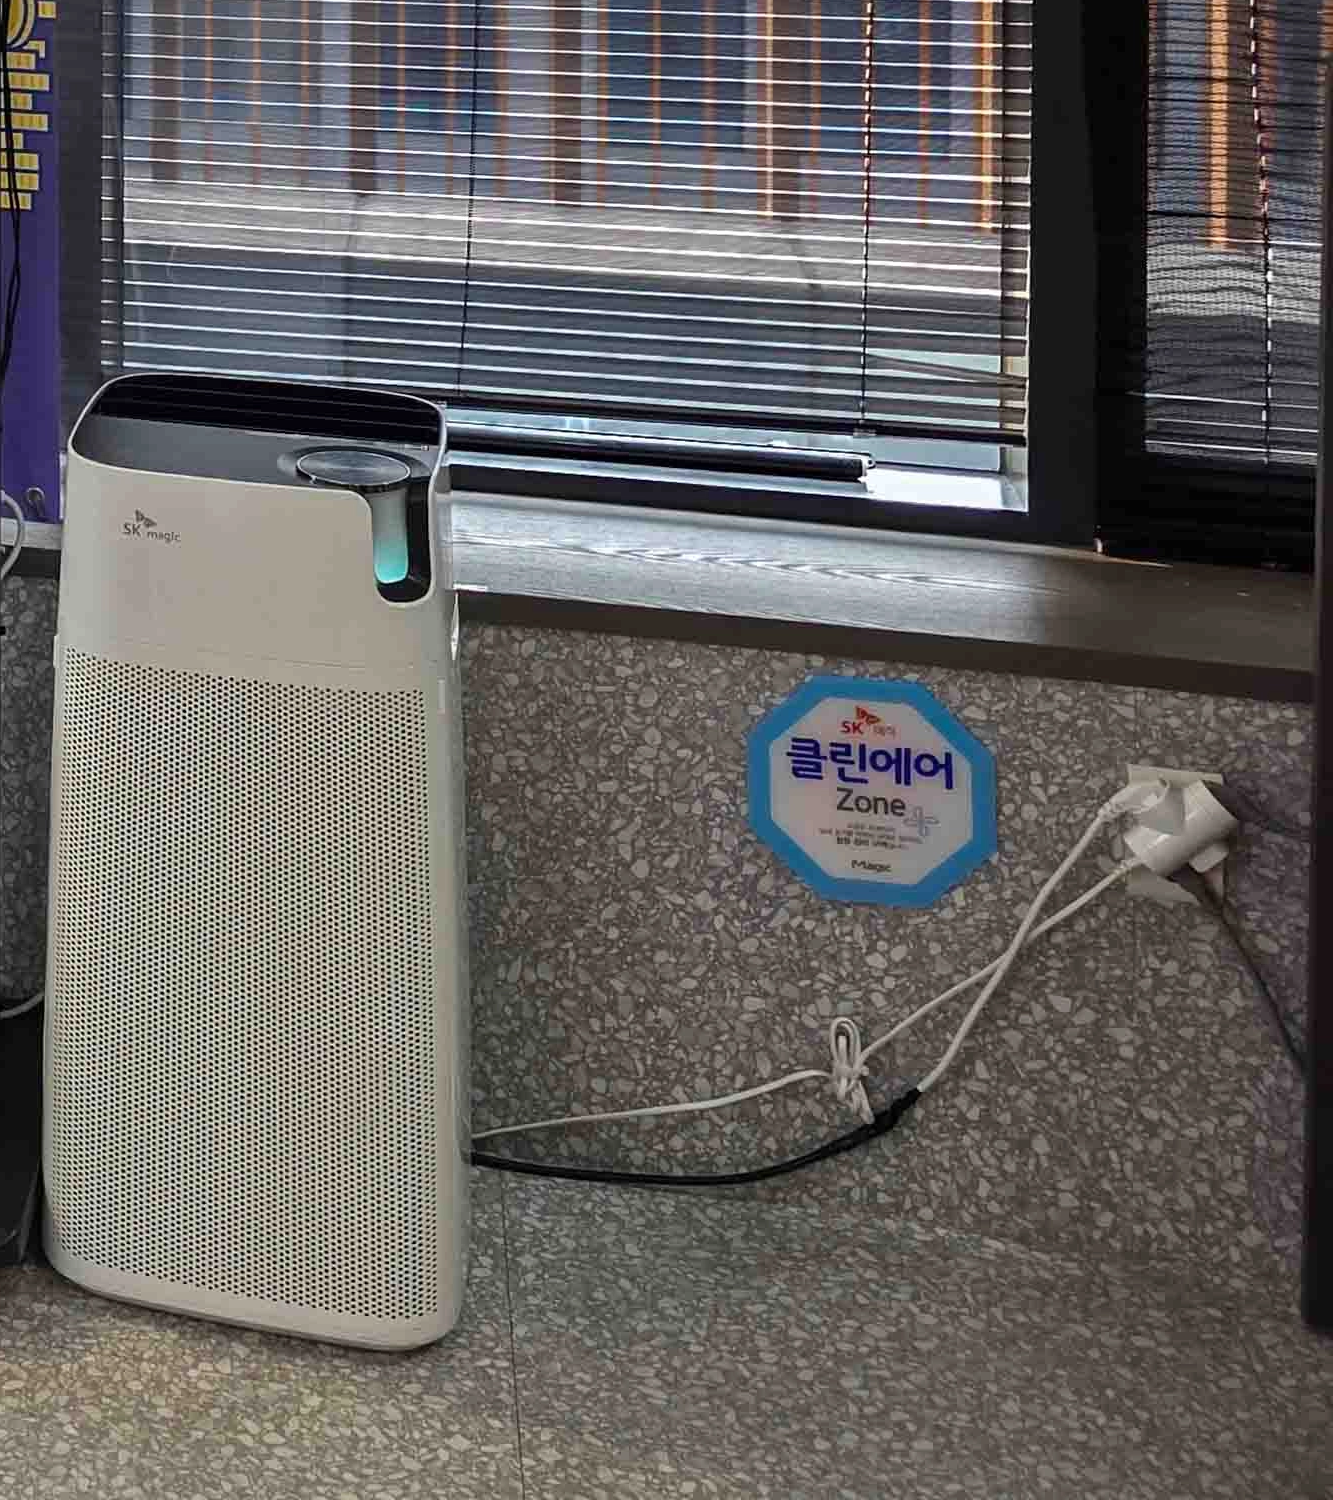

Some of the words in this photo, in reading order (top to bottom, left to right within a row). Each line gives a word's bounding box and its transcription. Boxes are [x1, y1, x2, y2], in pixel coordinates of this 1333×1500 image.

[122, 522, 142, 537] SK
[146, 531, 182, 545] magic
[840, 720, 865, 735] SK
[786, 737, 955, 791] 클린에어
[836, 787, 906, 817] Zone
